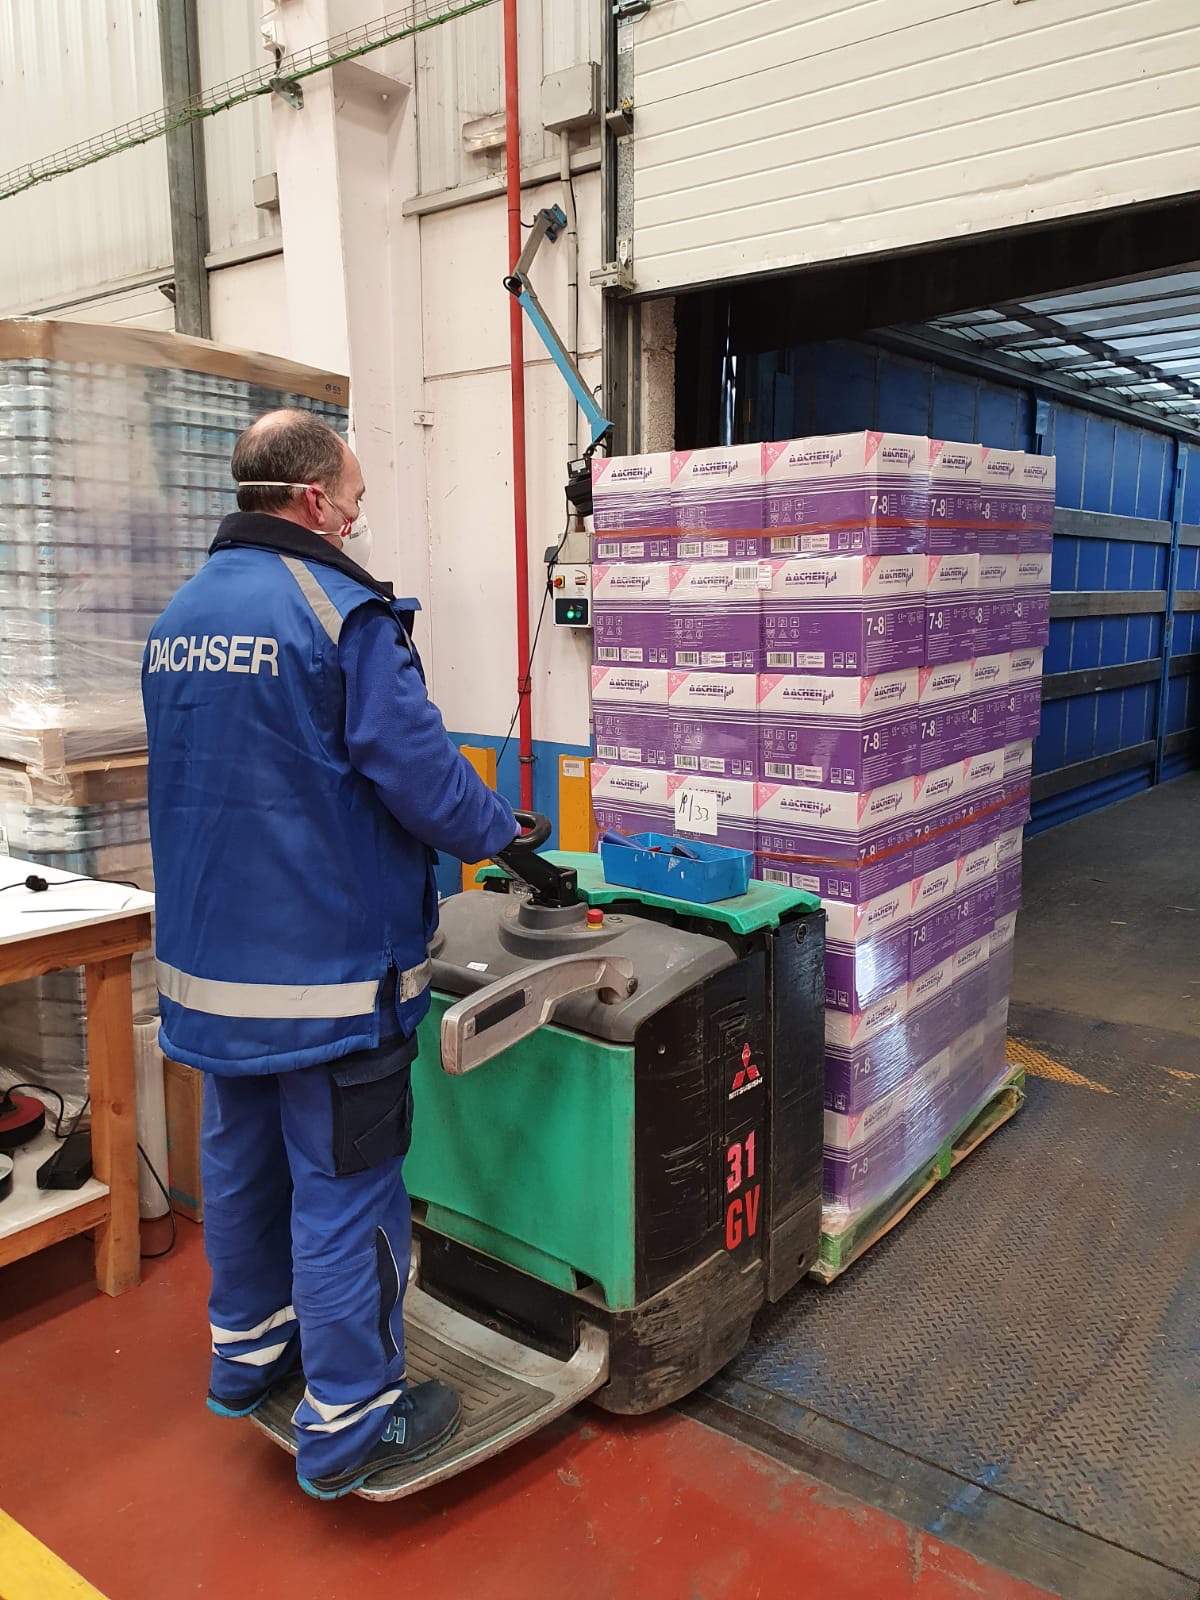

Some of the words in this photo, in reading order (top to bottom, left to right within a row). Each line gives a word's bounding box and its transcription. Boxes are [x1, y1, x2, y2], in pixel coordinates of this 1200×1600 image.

[869, 495, 888, 514] 7-8
[931, 499, 946, 517] 7-8
[980, 502, 990, 519] -8
[866, 617, 884, 636] 7-8
[929, 612, 943, 630] 7-8
[148, 635, 279, 677] DACHSER
[921, 720, 936, 739] 7-8
[863, 732, 880, 753] 7-8
[956, 902, 969, 921] 7-8
[913, 926, 927, 947] 7-8
[853, 1057, 871, 1081] 7-8
[726, 1131, 755, 1194] 31
[851, 1157, 869, 1181] 7-8
[726, 1184, 760, 1251] GV
